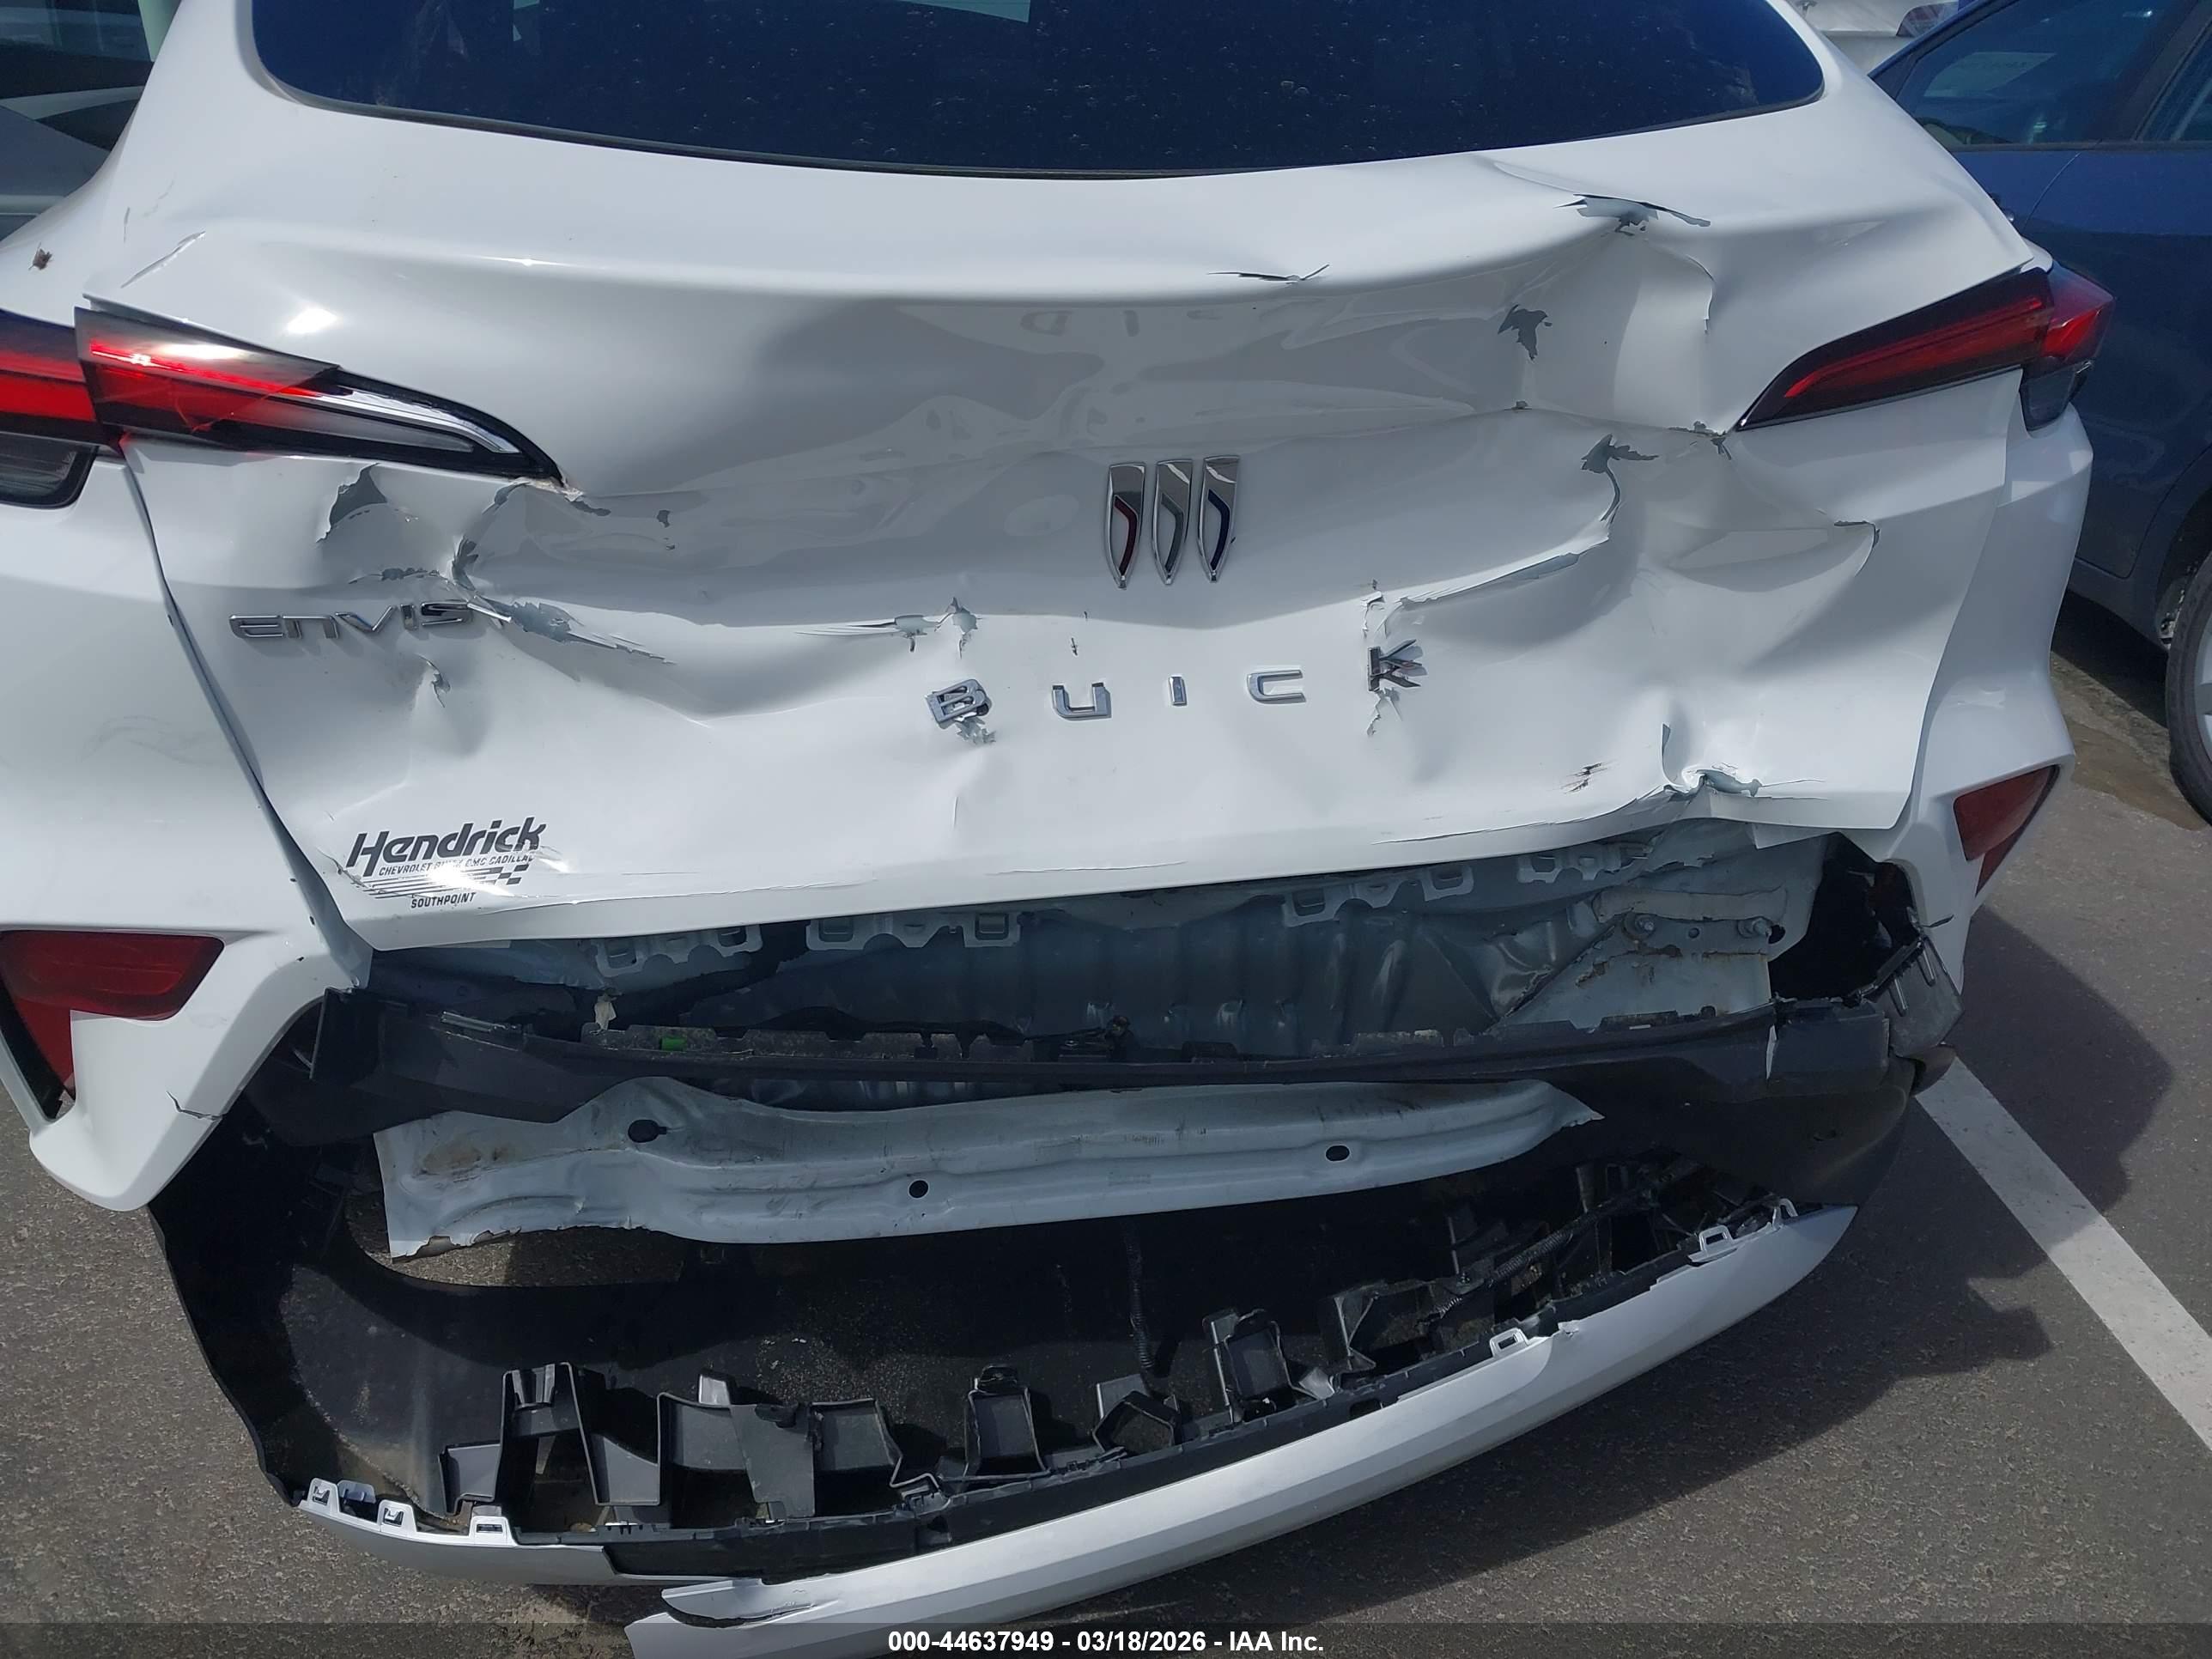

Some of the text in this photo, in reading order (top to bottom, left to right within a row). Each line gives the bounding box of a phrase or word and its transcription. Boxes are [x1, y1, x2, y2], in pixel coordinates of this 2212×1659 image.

[927, 639, 1425, 726] BUICK
[346, 816, 547, 877] Hendrick
[379, 862, 434, 876] CHEVROLET
[410, 892, 477, 908] SOUTHPOINT
